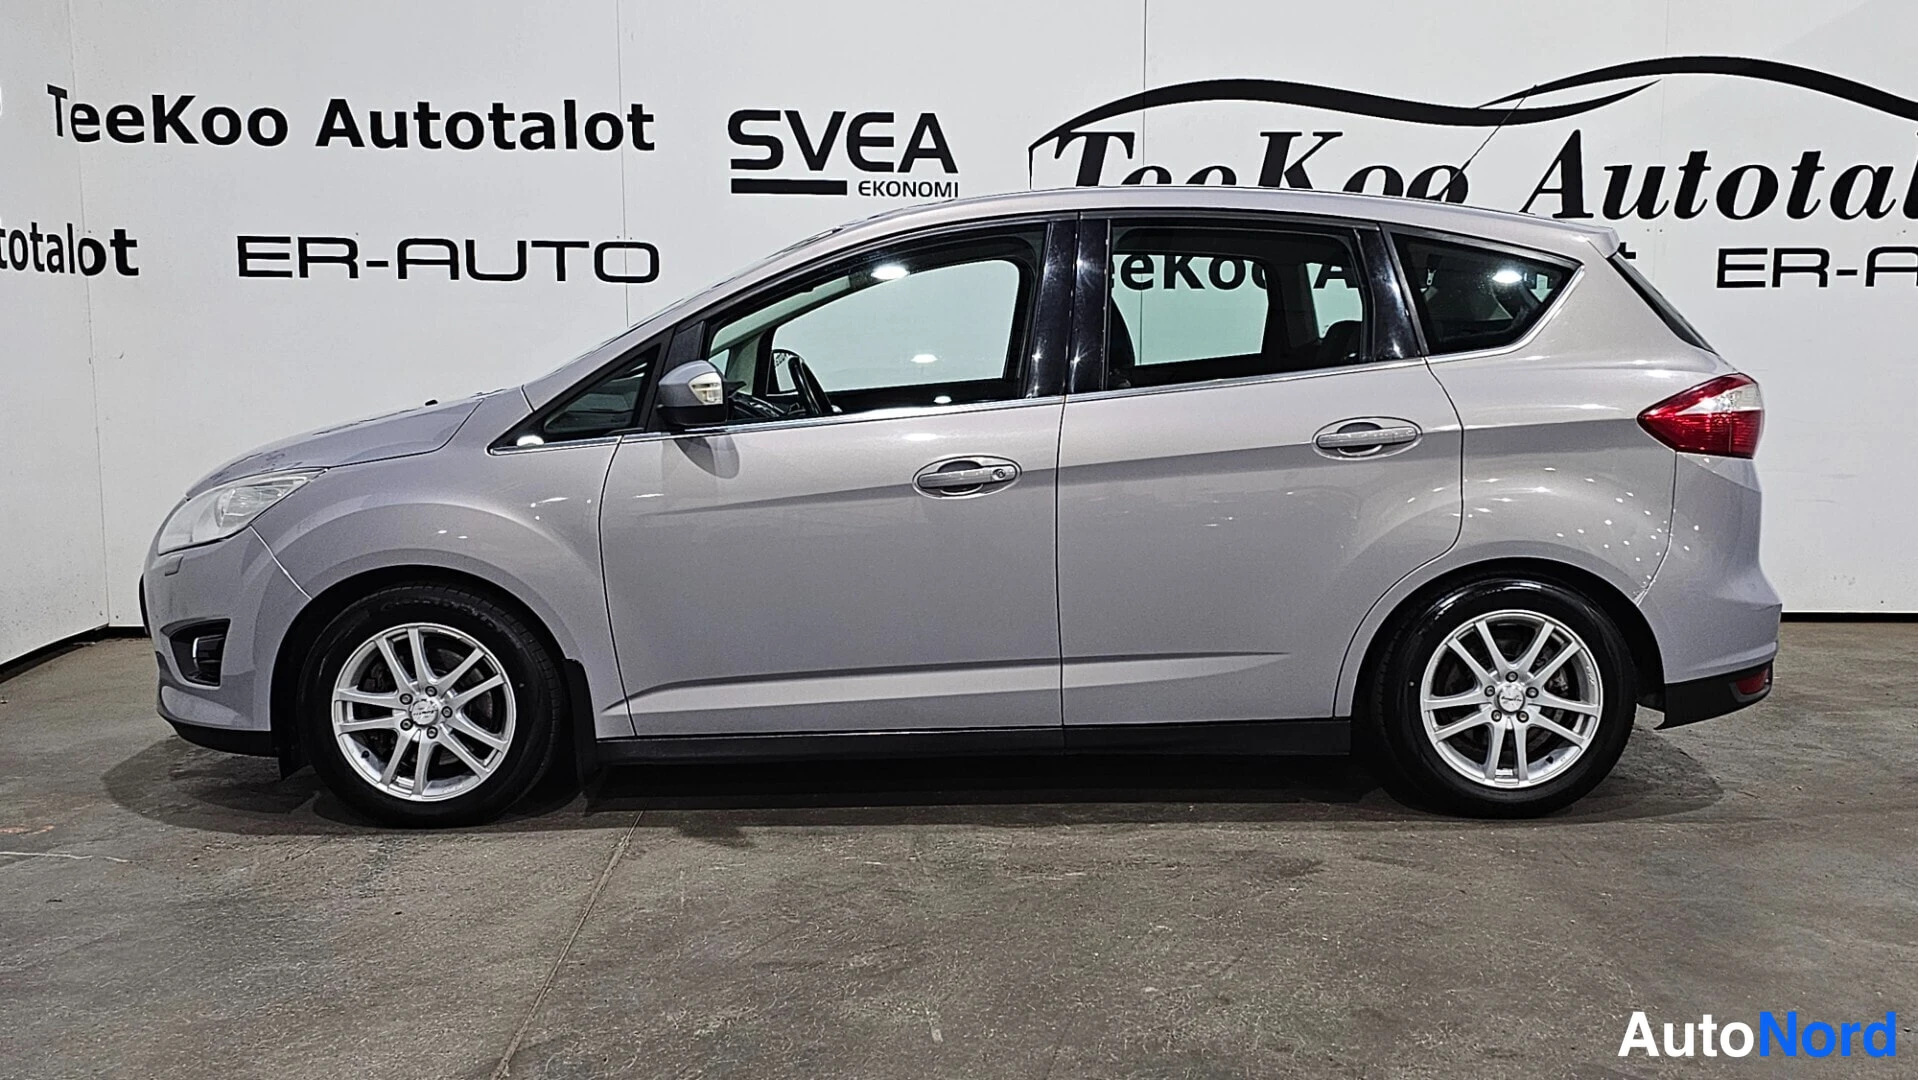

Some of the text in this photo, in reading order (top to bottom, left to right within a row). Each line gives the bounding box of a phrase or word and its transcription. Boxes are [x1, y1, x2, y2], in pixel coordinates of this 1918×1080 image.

[46, 83, 655, 151] TeeKoo Autotalot
[727, 110, 959, 174] SVEA
[858, 180, 959, 198] EKONOMI
[236, 235, 660, 284] ER-AUTO
